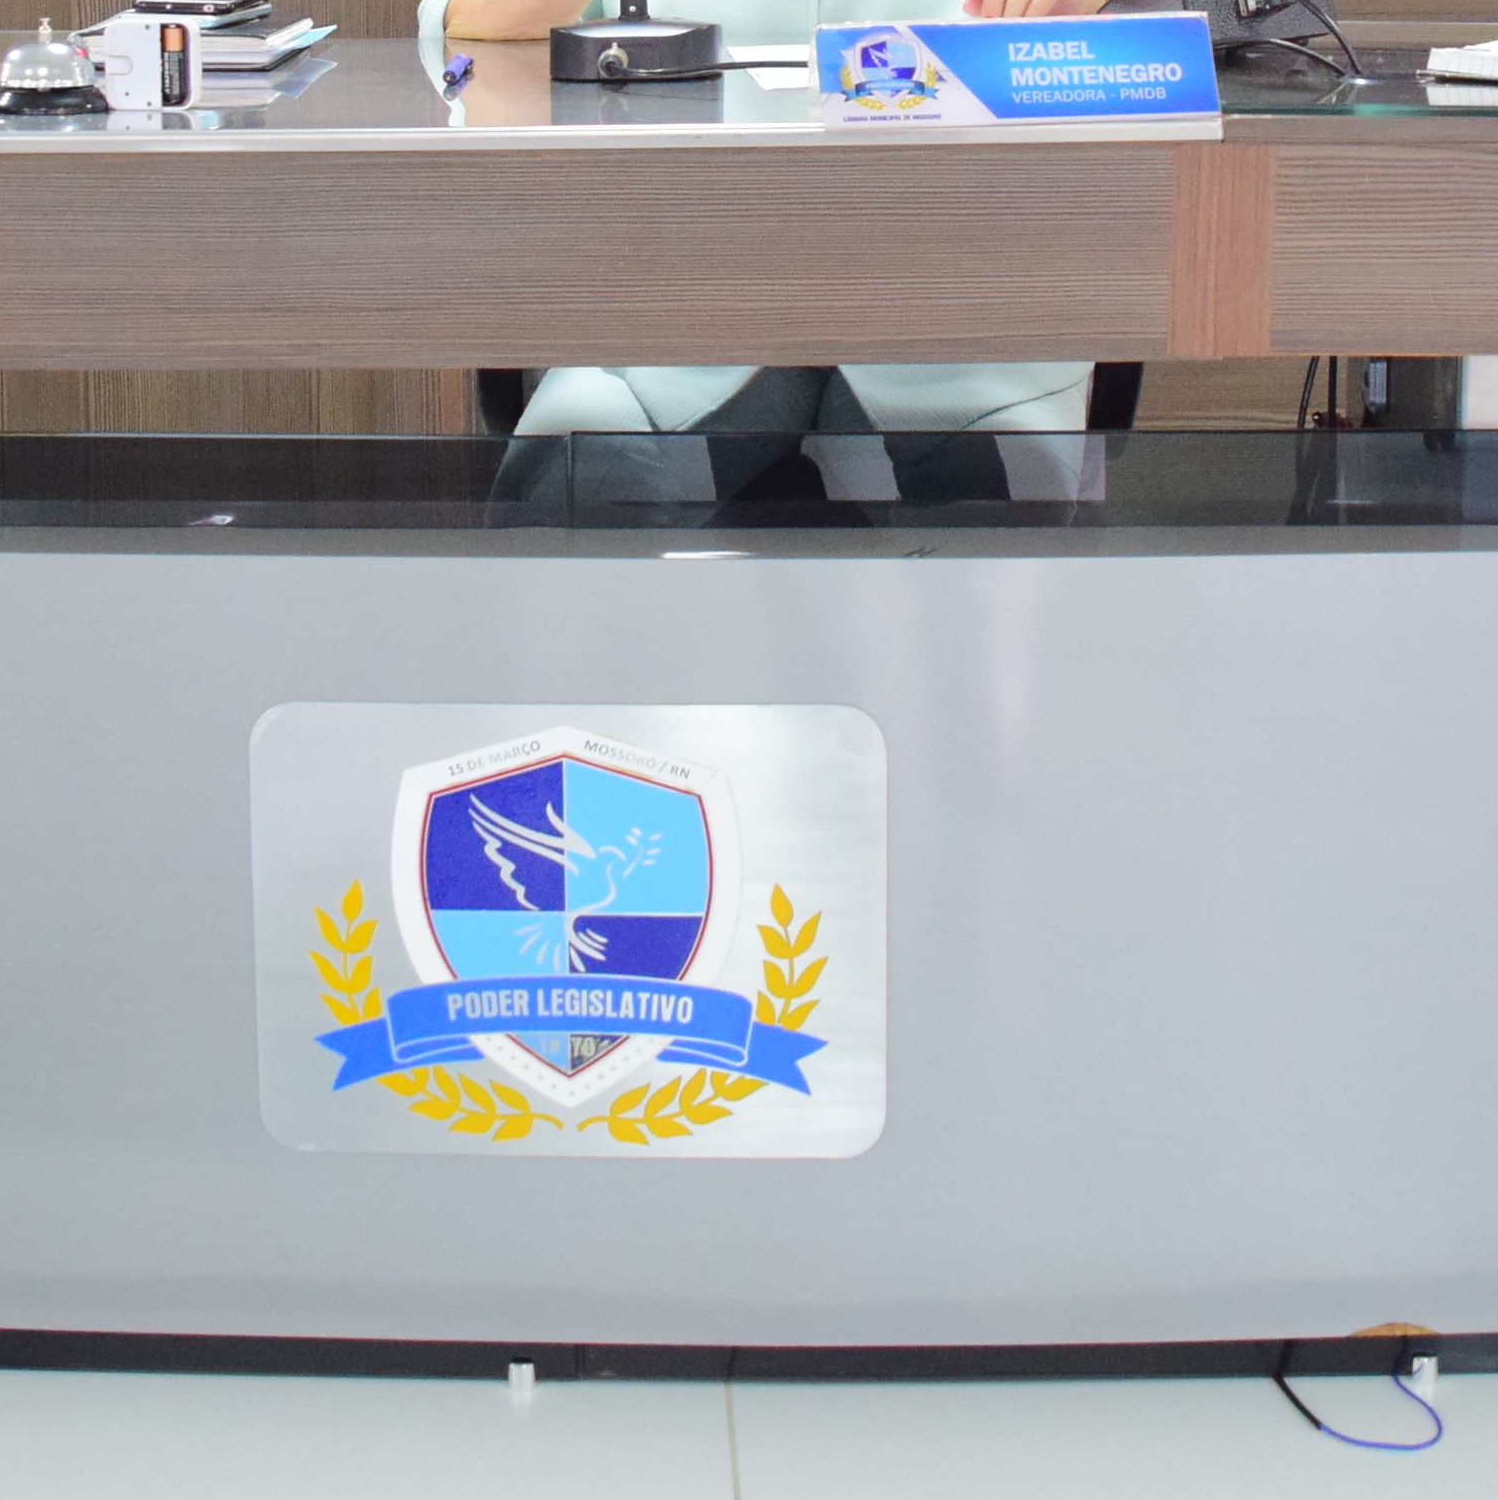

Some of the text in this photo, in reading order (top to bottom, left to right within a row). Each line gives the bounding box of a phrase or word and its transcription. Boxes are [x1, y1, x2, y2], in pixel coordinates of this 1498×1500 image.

[1008, 41, 1095, 62] IZABEL
[1011, 63, 1183, 87] MONTENEGRO
[1012, 88, 1106, 104] VEREADORA
[1120, 86, 1167, 100] PMDB
[448, 740, 541, 777] 15 DE MARÇO
[670, 766, 691, 780] RN
[447, 988, 695, 1024] PODER LEGISLATIVO
